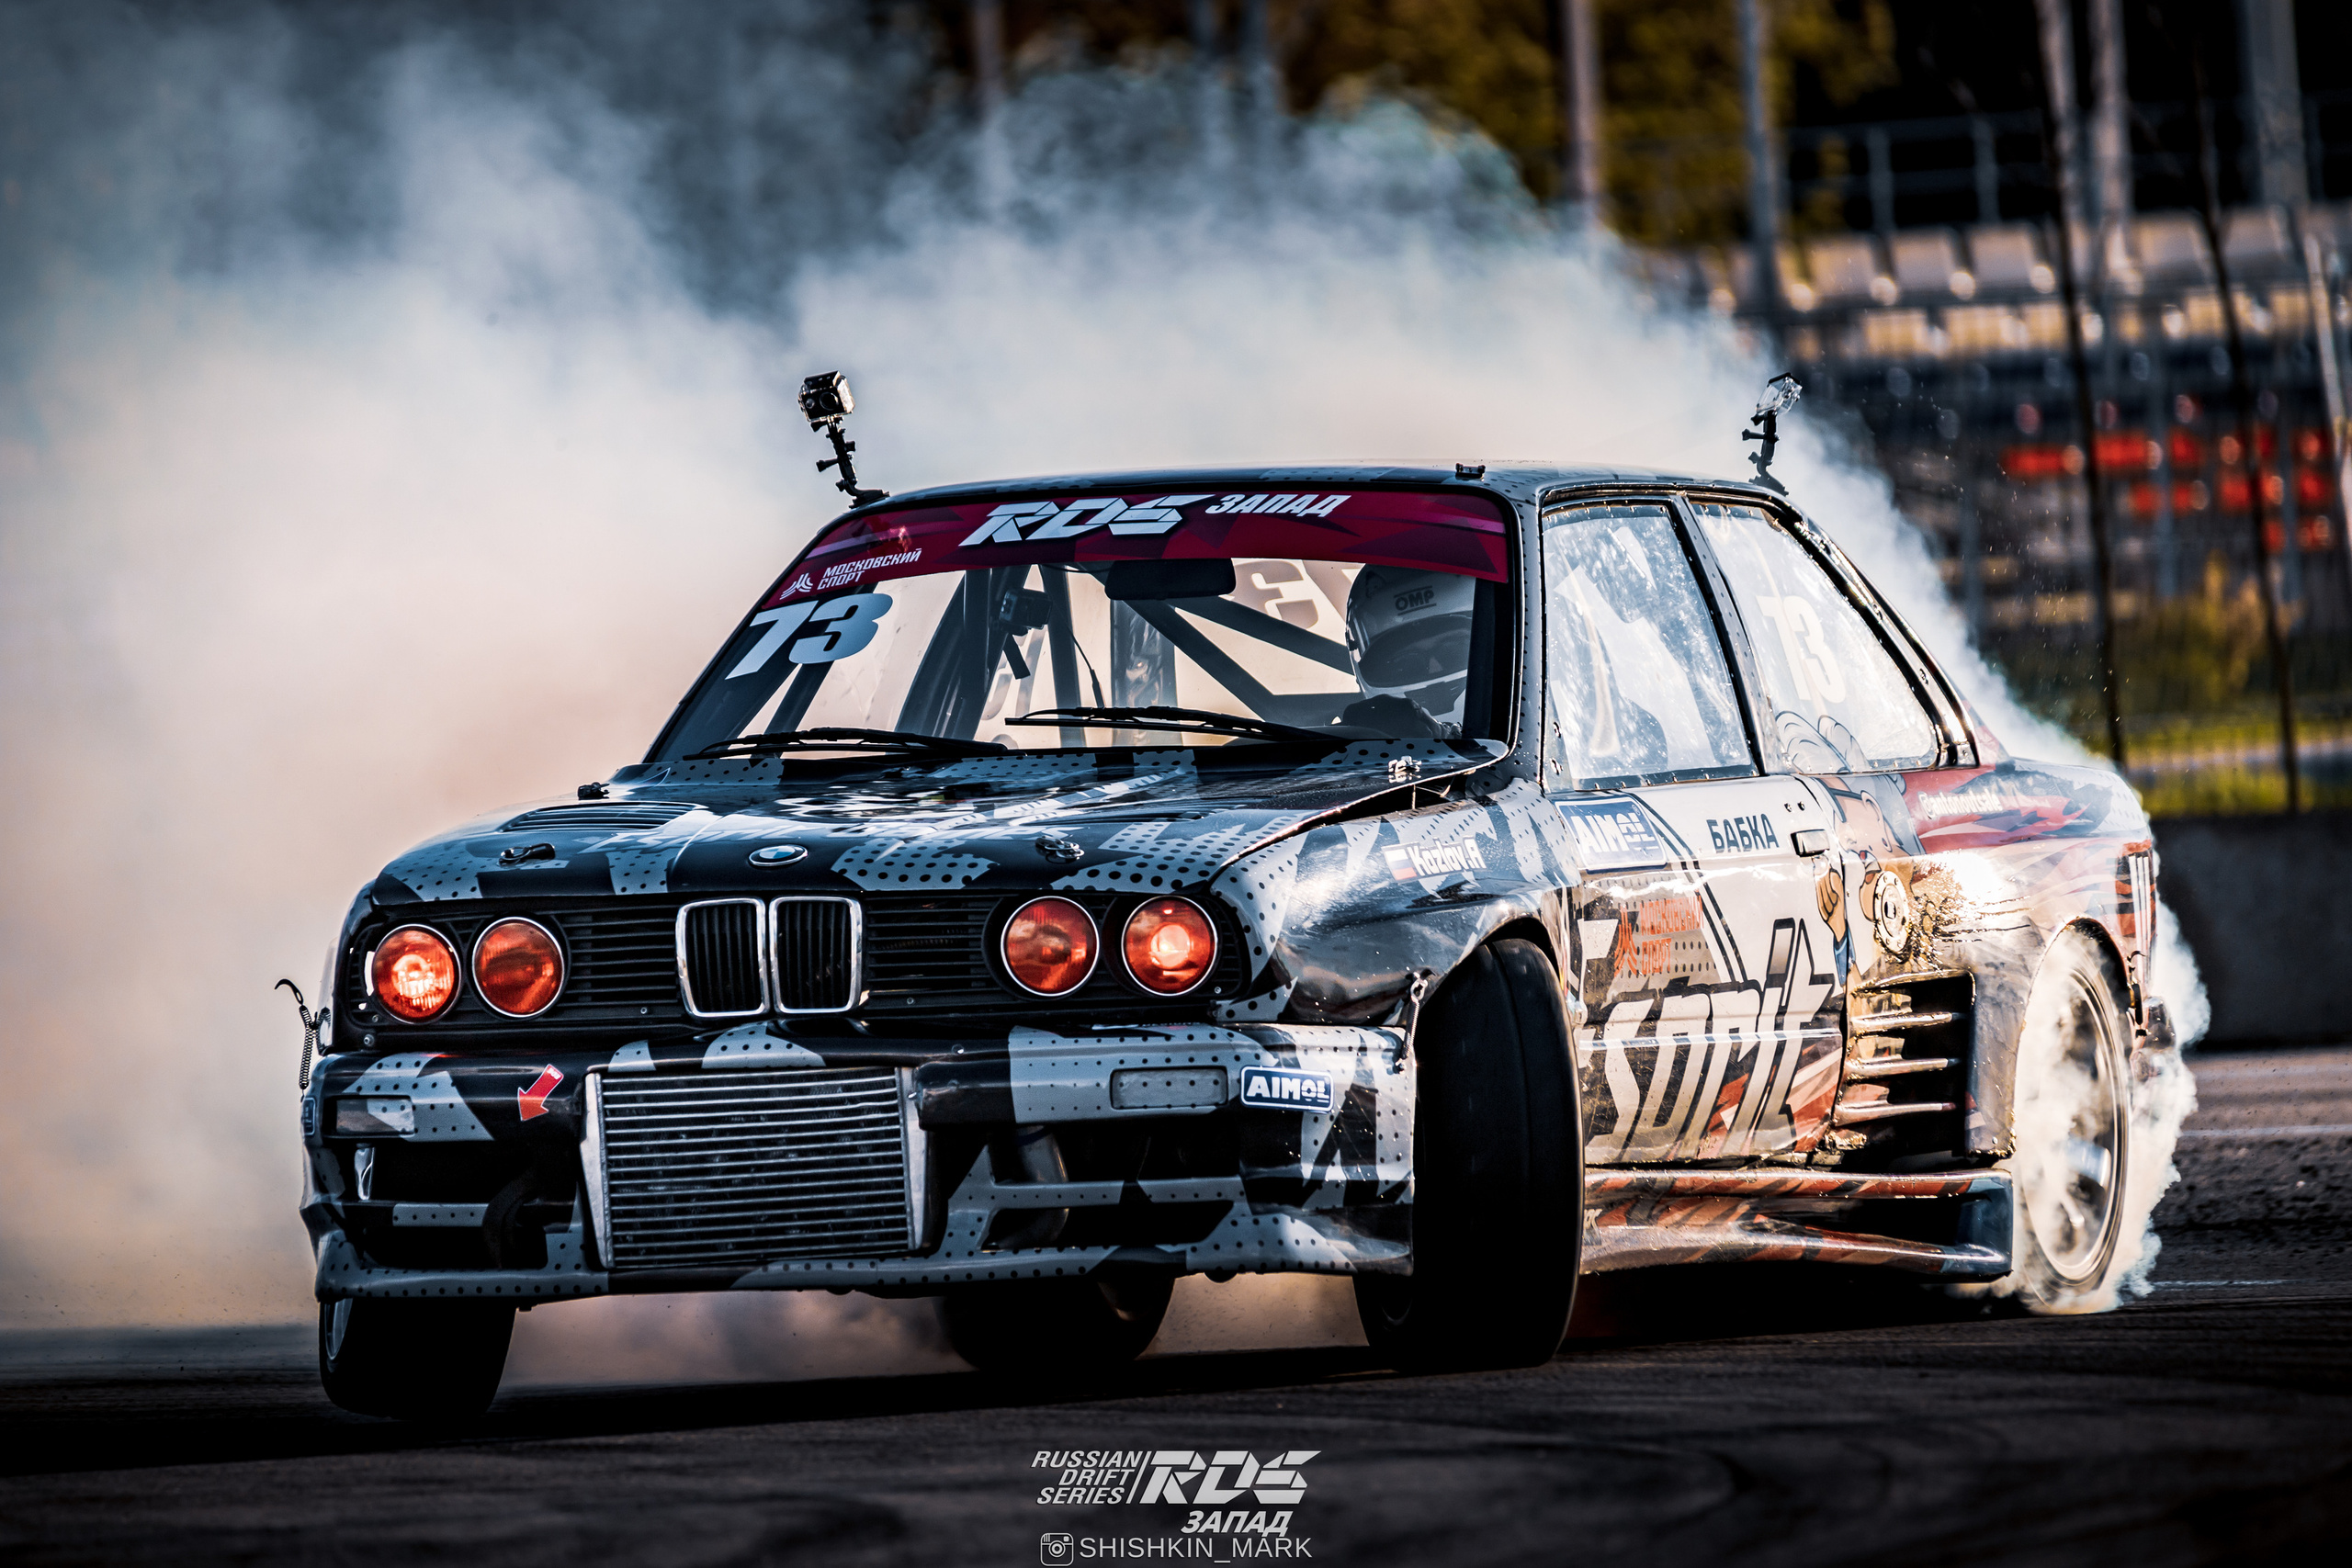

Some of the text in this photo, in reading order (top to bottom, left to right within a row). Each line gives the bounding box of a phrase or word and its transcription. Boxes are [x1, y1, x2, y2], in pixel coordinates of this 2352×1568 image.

[958, 493, 1216, 547] RDS
[1205, 494, 1351, 517] ЗАПАД
[822, 548, 922, 577] МОСКОВСКИЙ
[817, 570, 865, 591] СПОРТ
[1395, 587, 1435, 611] OMP
[724, 592, 893, 680] 73
[1756, 594, 1846, 704] 73
[1706, 813, 1780, 853] БАБКА
[1246, 1076, 1329, 1103] AIMOL
